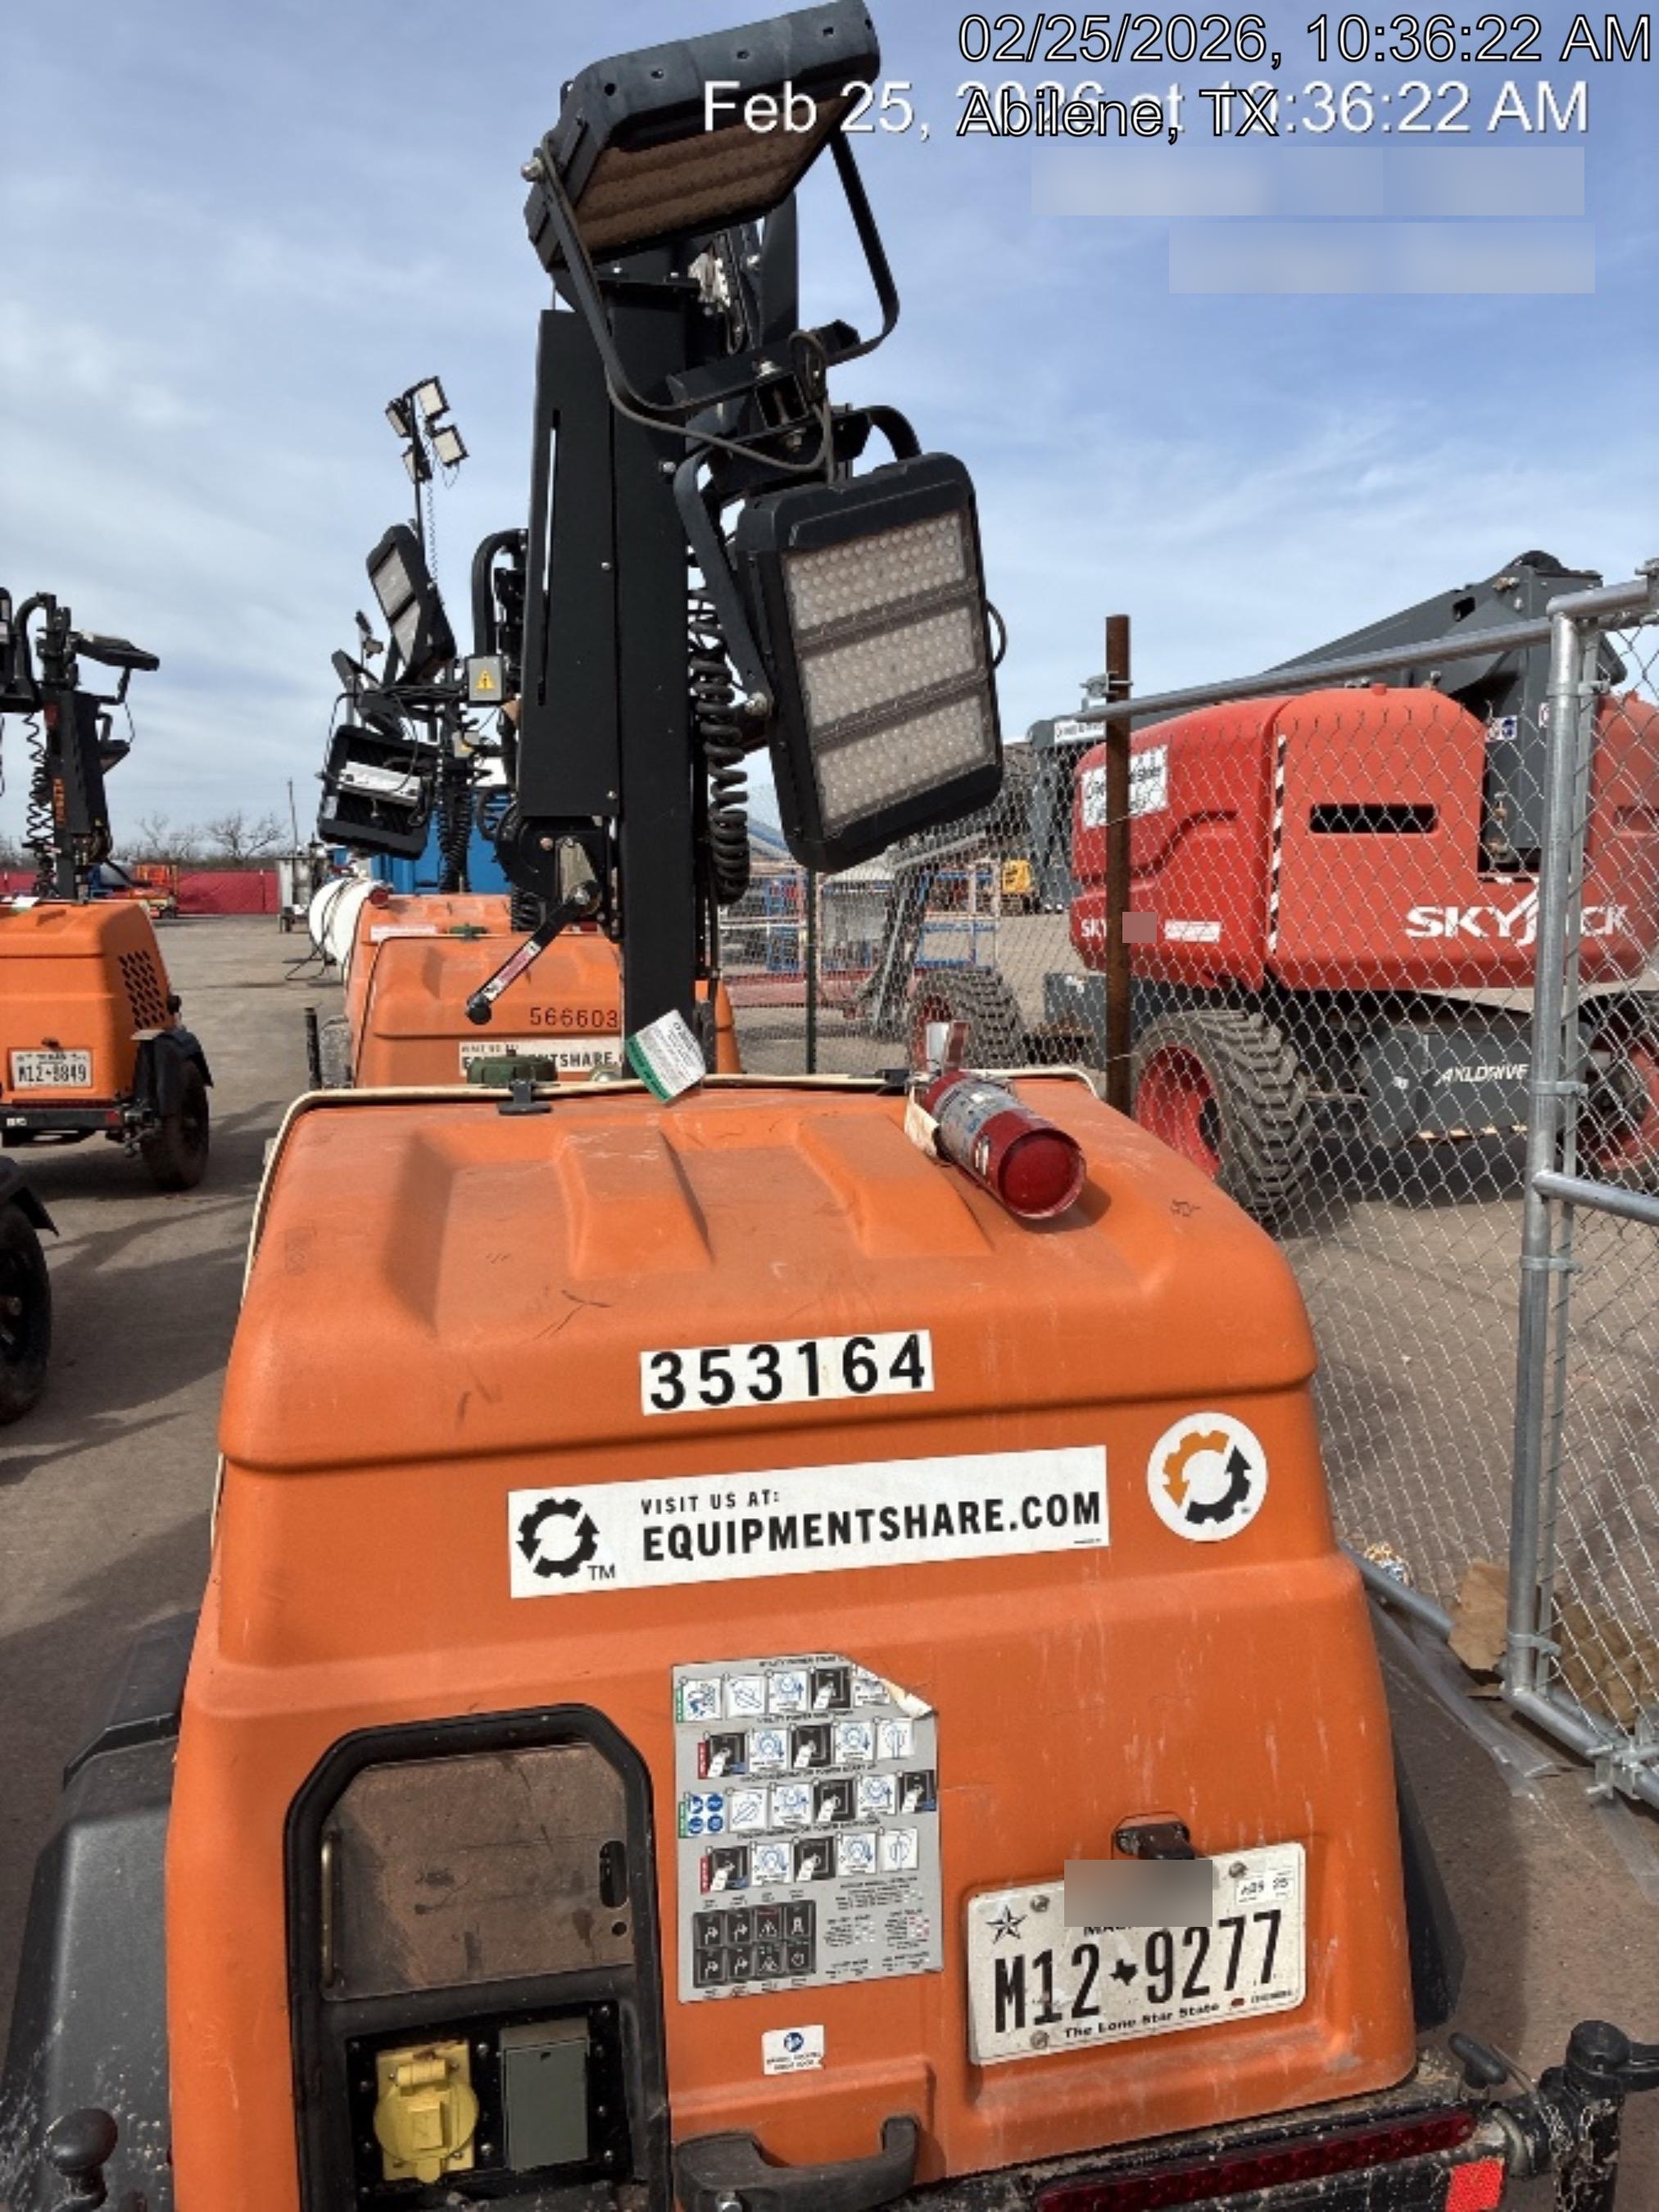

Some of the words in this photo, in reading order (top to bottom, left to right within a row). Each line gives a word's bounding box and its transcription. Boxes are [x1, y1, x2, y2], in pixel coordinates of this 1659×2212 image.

[529, 1007, 619, 1029] 566603
[650, 1333, 926, 1411] 353164
[641, 1494, 699, 1516] VISIT
[709, 1490, 737, 1510] US
[746, 1488, 780, 1508] AT:
[642, 1491, 1100, 1562] EQUIPMENTSHARE.COM
[587, 1563, 616, 1581] TM
[994, 1942, 1100, 2033] M12
[1145, 1909, 1282, 2005] 9277
[1065, 2027, 1092, 2039] The
[1098, 2018, 1137, 2033] Lone
[1142, 2011, 1174, 2025] Star
[1179, 2002, 1220, 2018] State
